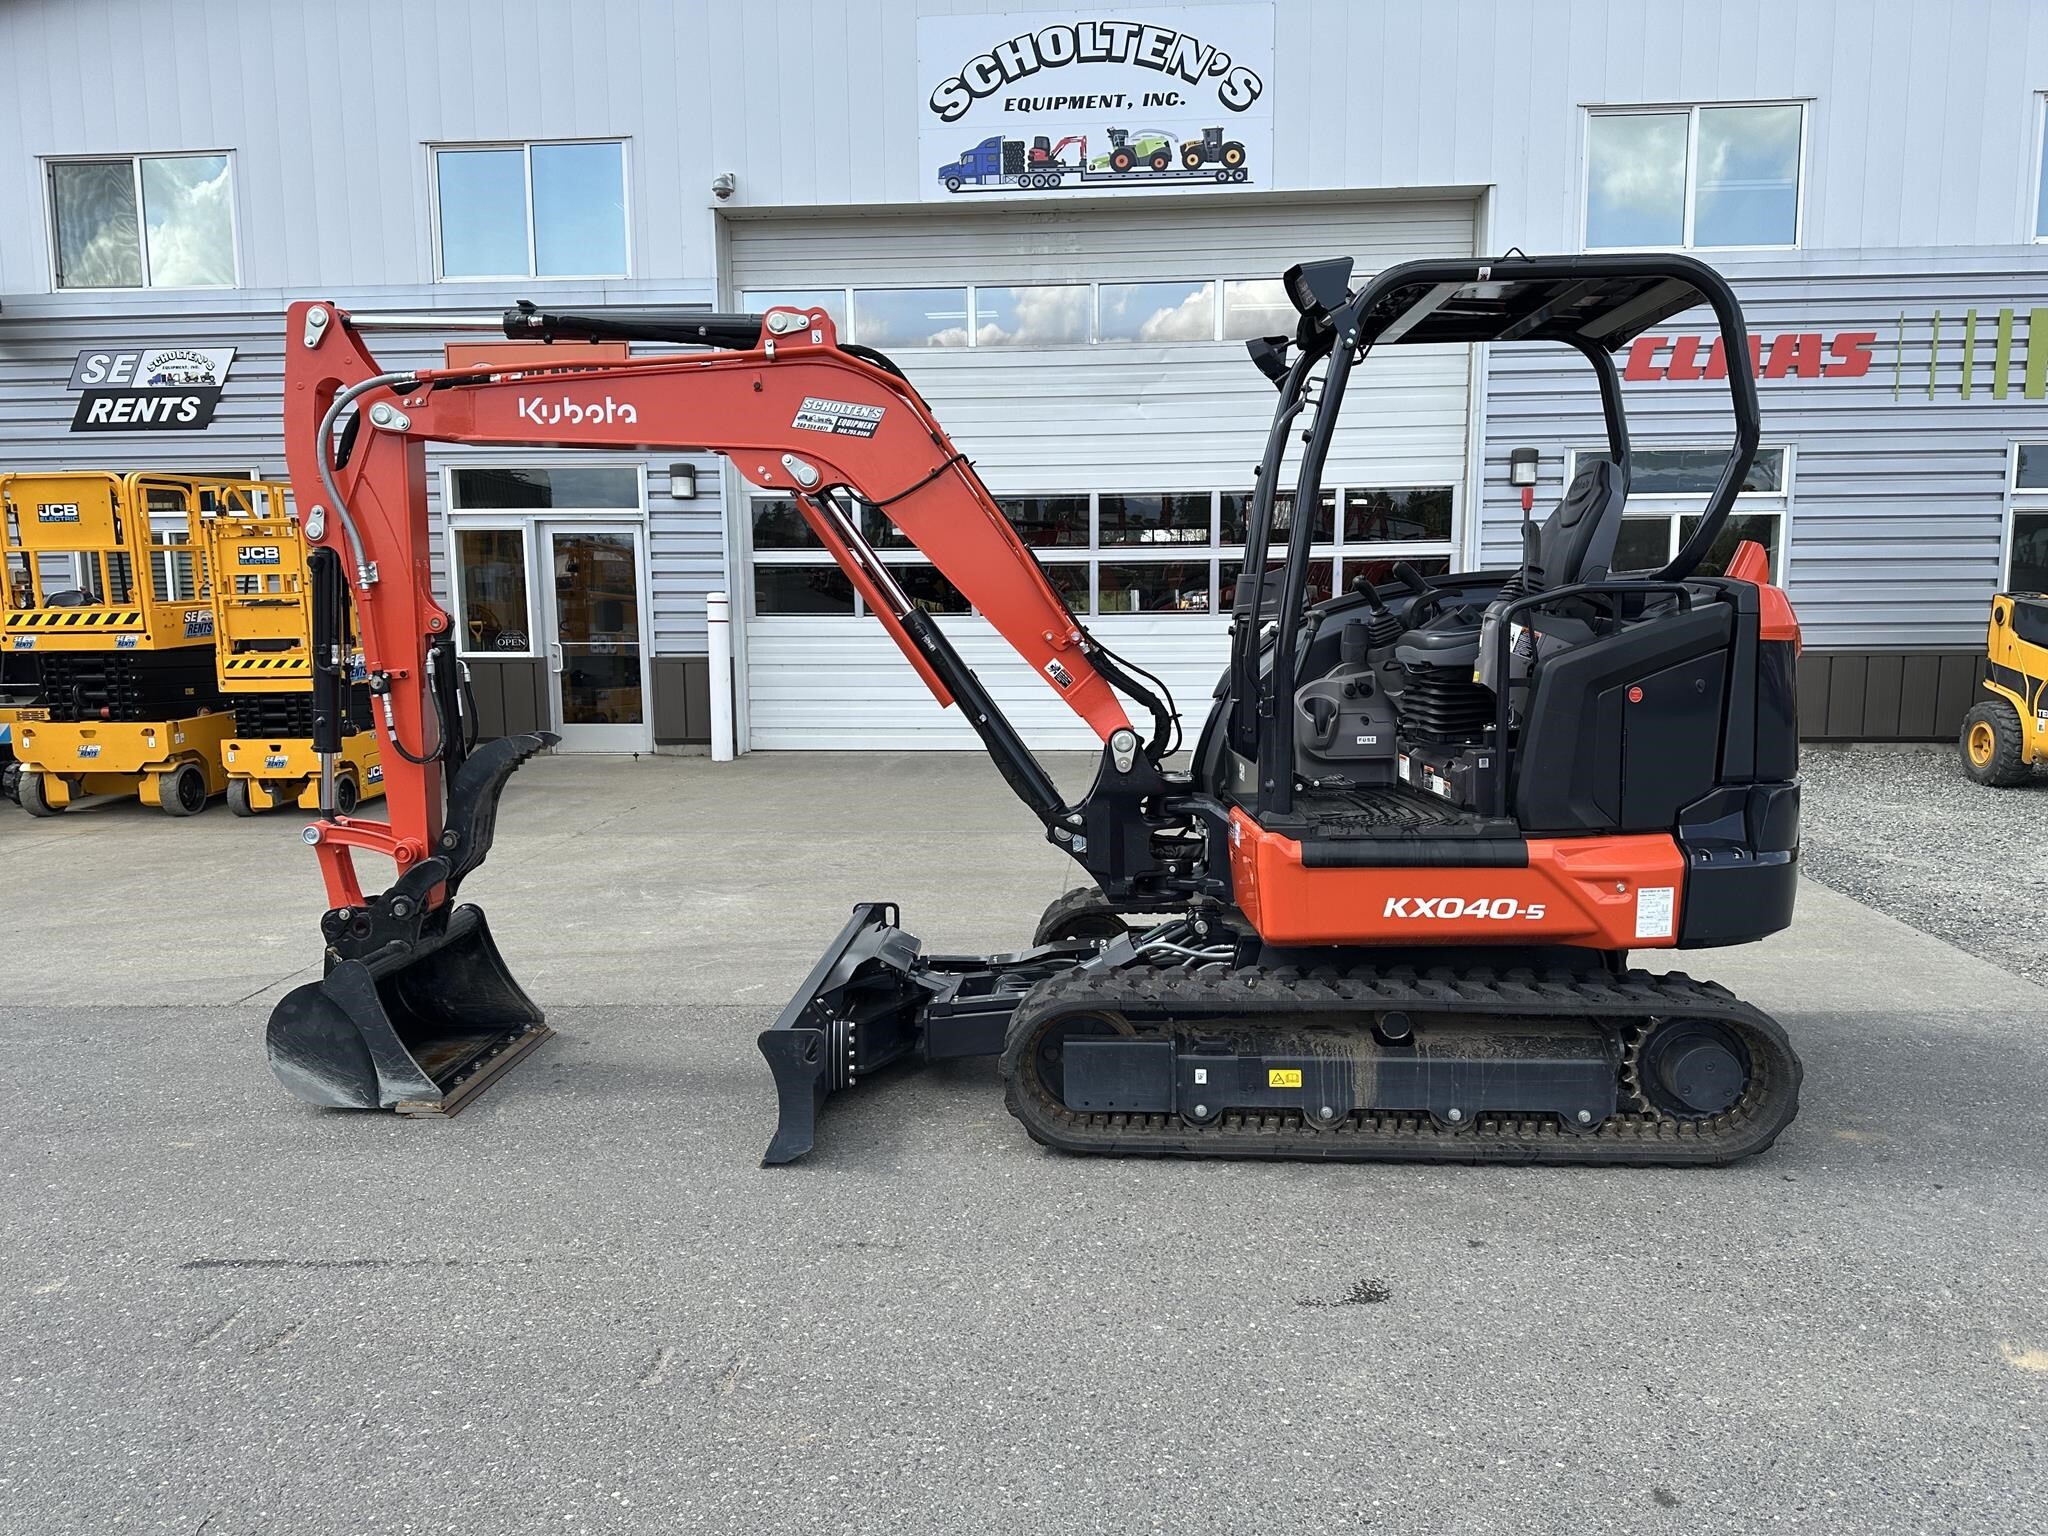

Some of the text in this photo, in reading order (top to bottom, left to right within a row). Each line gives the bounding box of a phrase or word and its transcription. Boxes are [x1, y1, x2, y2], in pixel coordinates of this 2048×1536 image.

[929, 21, 1263, 122] SCHOLTEN'S
[1004, 92, 1186, 112] EQUIPMENT, INC.
[80, 354, 138, 384] SE
[147, 350, 216, 373] SCHOLTEN'S
[86, 396, 201, 424] RENTS
[518, 396, 638, 425] Kubota
[803, 399, 882, 419] SCHOLTEN'S
[837, 418, 877, 430] EQUIPMENT
[39, 504, 78, 516] JCB
[239, 547, 279, 559] JCB
[184, 611, 198, 623] SE
[187, 623, 213, 635] RENTS
[1383, 897, 1546, 919] KX040-5
